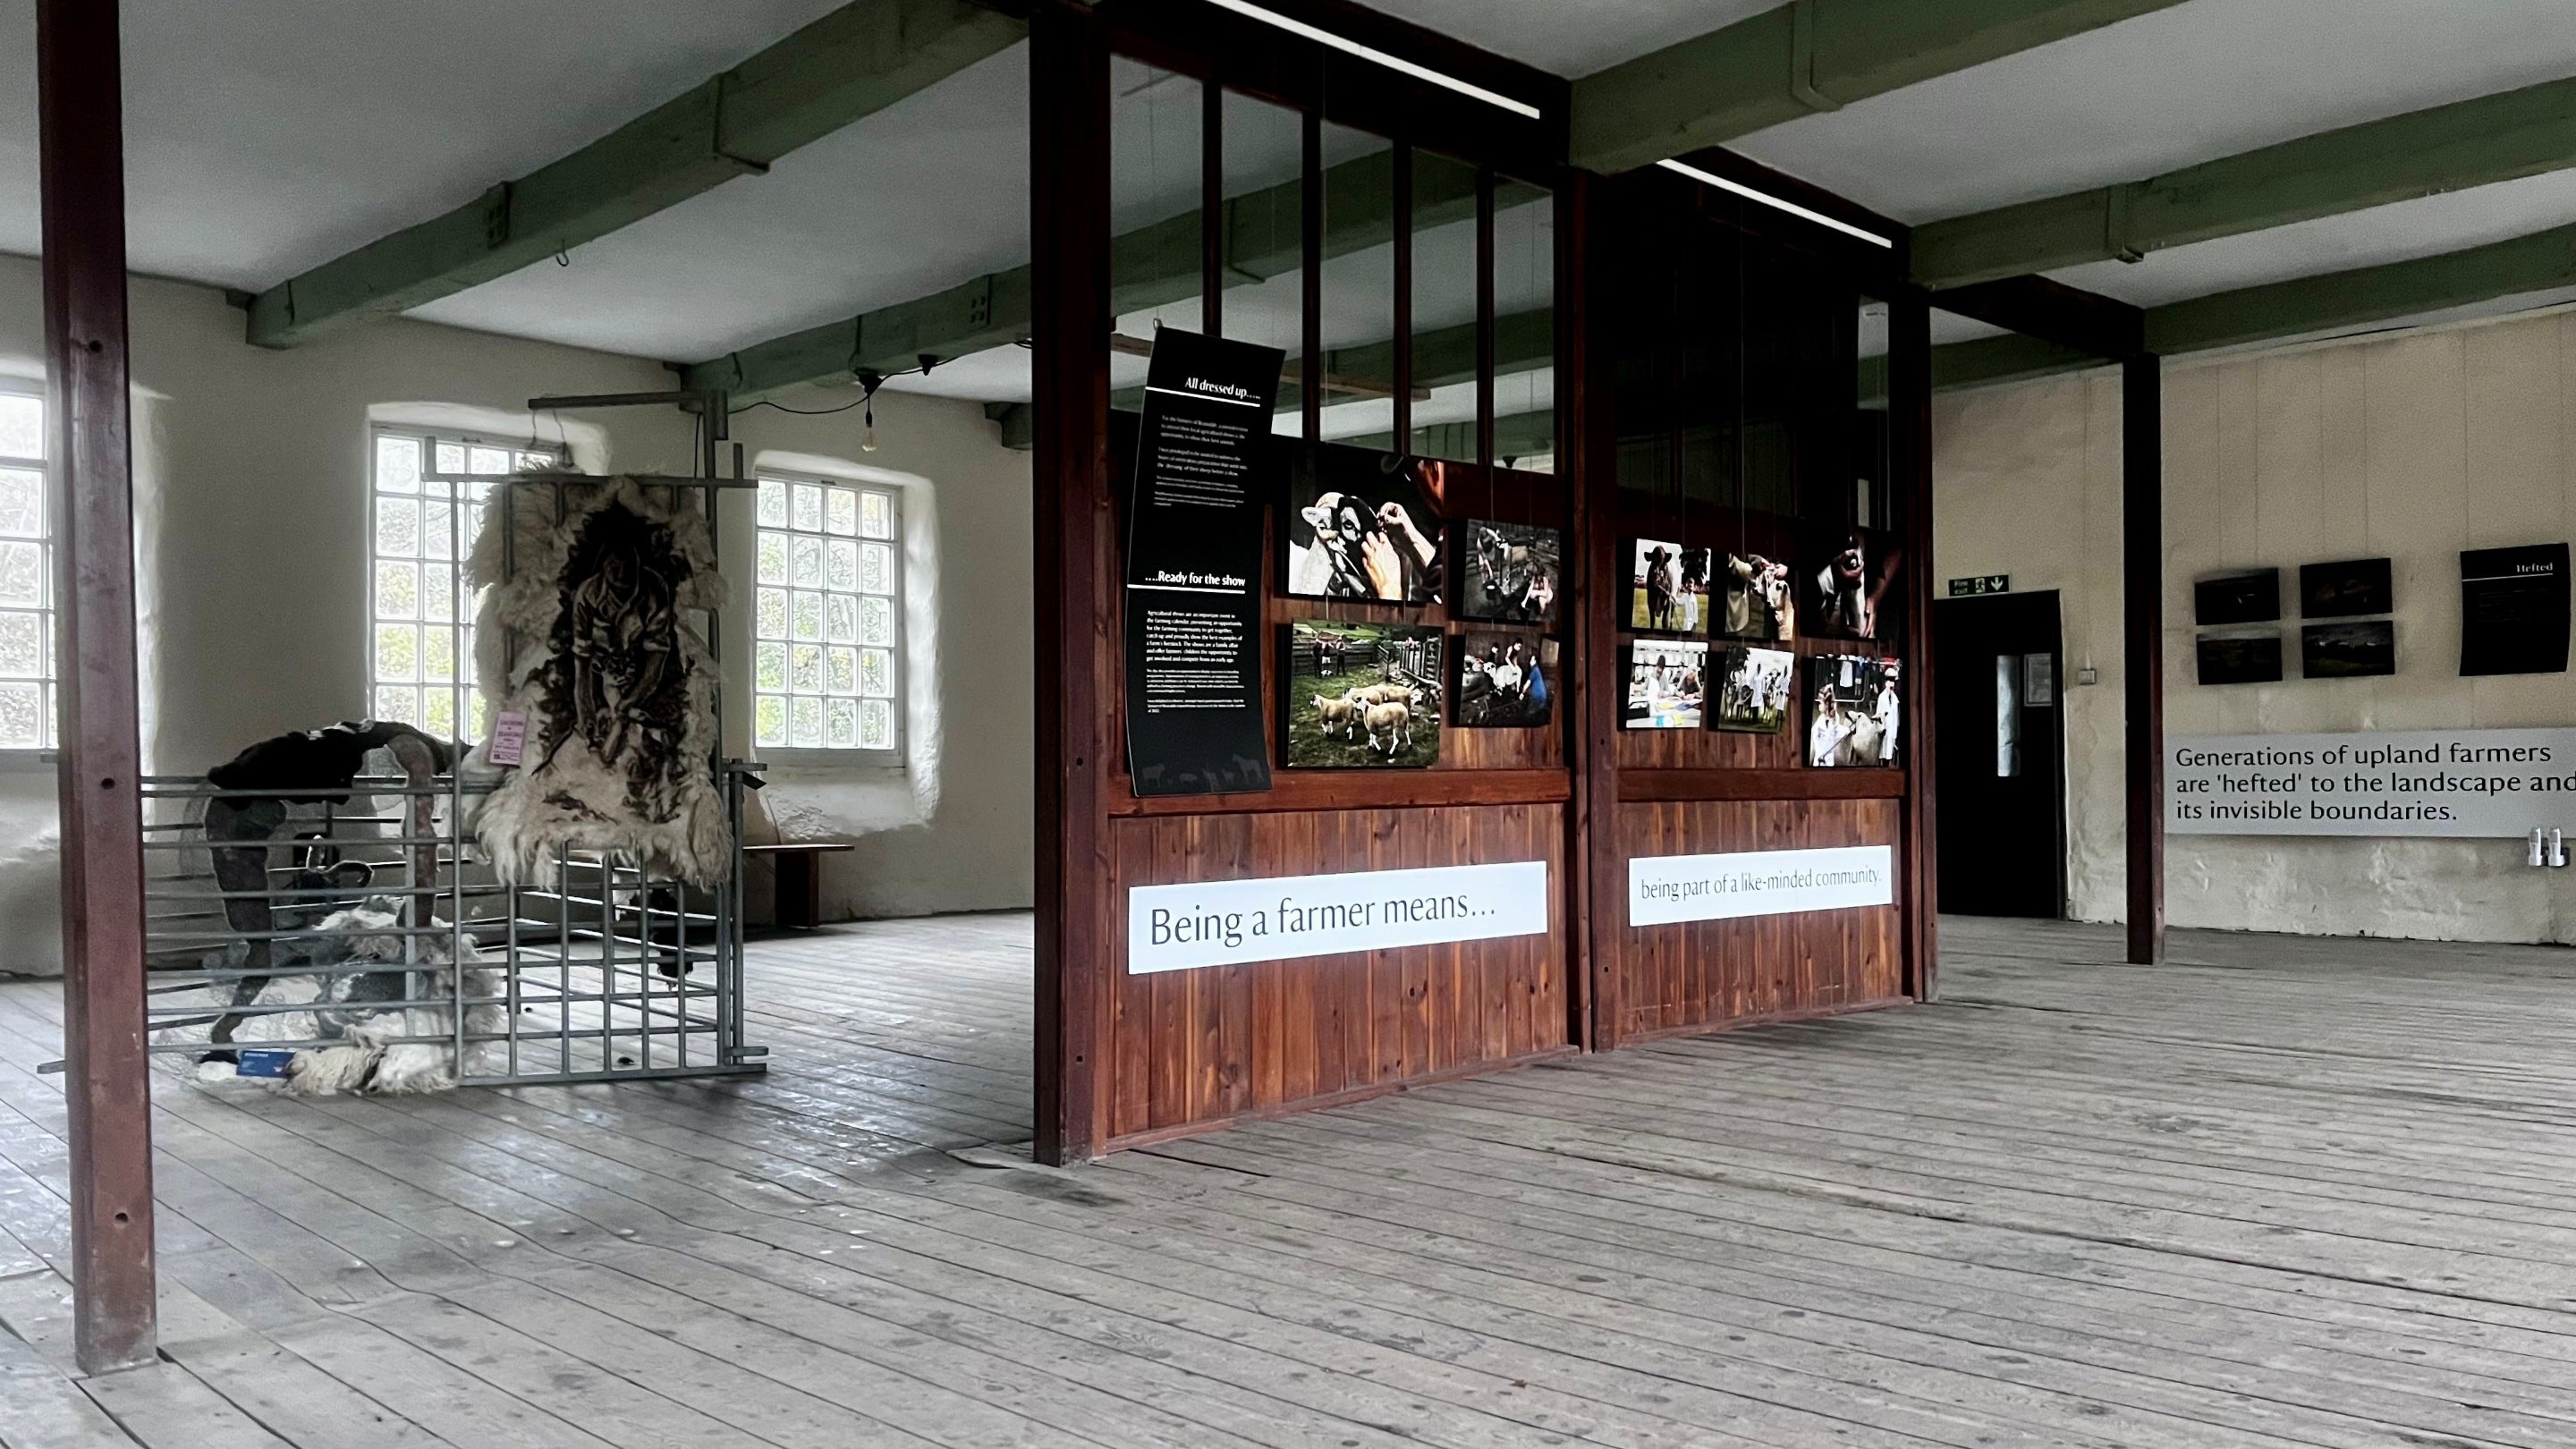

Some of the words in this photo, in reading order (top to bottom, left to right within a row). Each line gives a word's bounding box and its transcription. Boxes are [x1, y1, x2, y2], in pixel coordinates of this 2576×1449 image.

[1185, 377, 1198, 389] All
[1199, 379, 1234, 394] dressed
[1189, 572, 1203, 584] for
[1205, 574, 1220, 585] the
[1222, 575, 1245, 586] show
[2176, 747, 2314, 767] Generations
[2322, 744, 2349, 765] of
[2354, 743, 2440, 768] upland
[2450, 743, 2552, 763] farmers
[2176, 777, 2209, 792] are
[2217, 773, 2301, 792] 'hefted'
[2310, 775, 2334, 792] to
[2343, 774, 2383, 792] the
[2392, 772, 2521, 795] landscape
[2529, 771, 2576, 791] and
[2177, 801, 2202, 818] its
[2210, 801, 2302, 818] invisible
[2310, 801, 2458, 820] boundaries.
[1641, 878, 1680, 902] being
[1682, 879, 1709, 902] part
[1714, 873, 1728, 894] of
[1731, 877, 1737, 892] a
[1741, 868, 1812, 892] like-minded
[1815, 864, 1882, 887] community.
[1151, 904, 1242, 948] Being
[1252, 911, 1269, 936] a
[1279, 897, 1375, 934] farmer
[1384, 894, 1496, 924] means...
